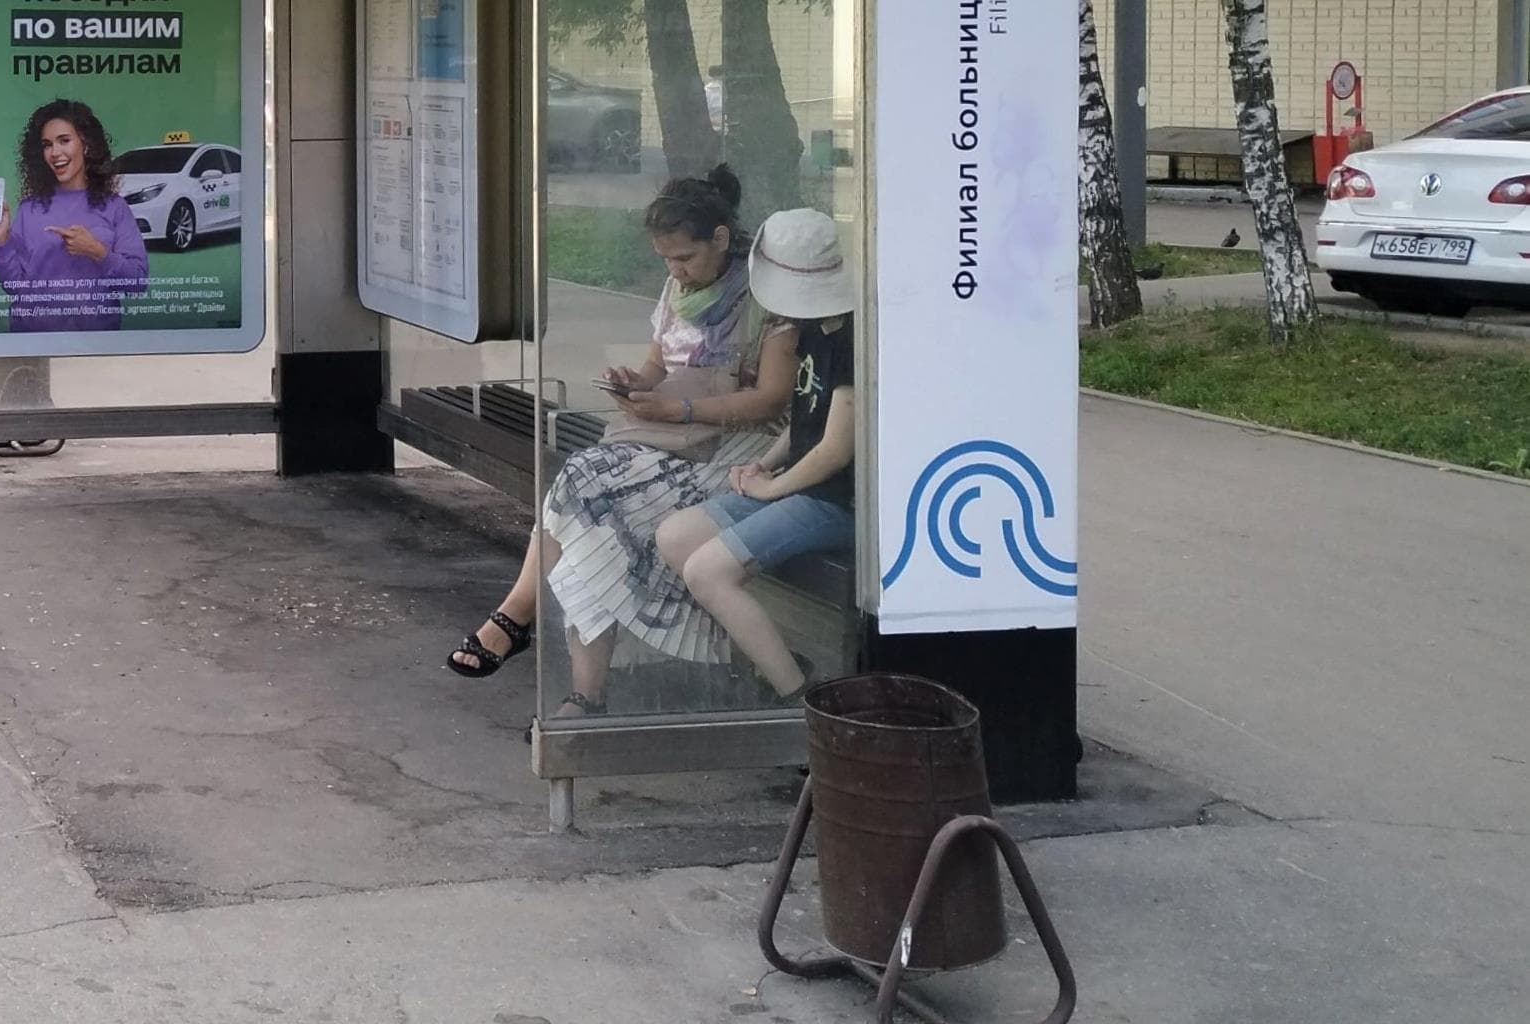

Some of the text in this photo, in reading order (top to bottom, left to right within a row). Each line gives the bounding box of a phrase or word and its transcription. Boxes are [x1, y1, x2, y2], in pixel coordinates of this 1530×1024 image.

[13, 17, 180, 39] по вашим
[13, 53, 181, 82] правилам
[951, 163, 979, 300] Филиал
[1441, 239, 1467, 253] 799
